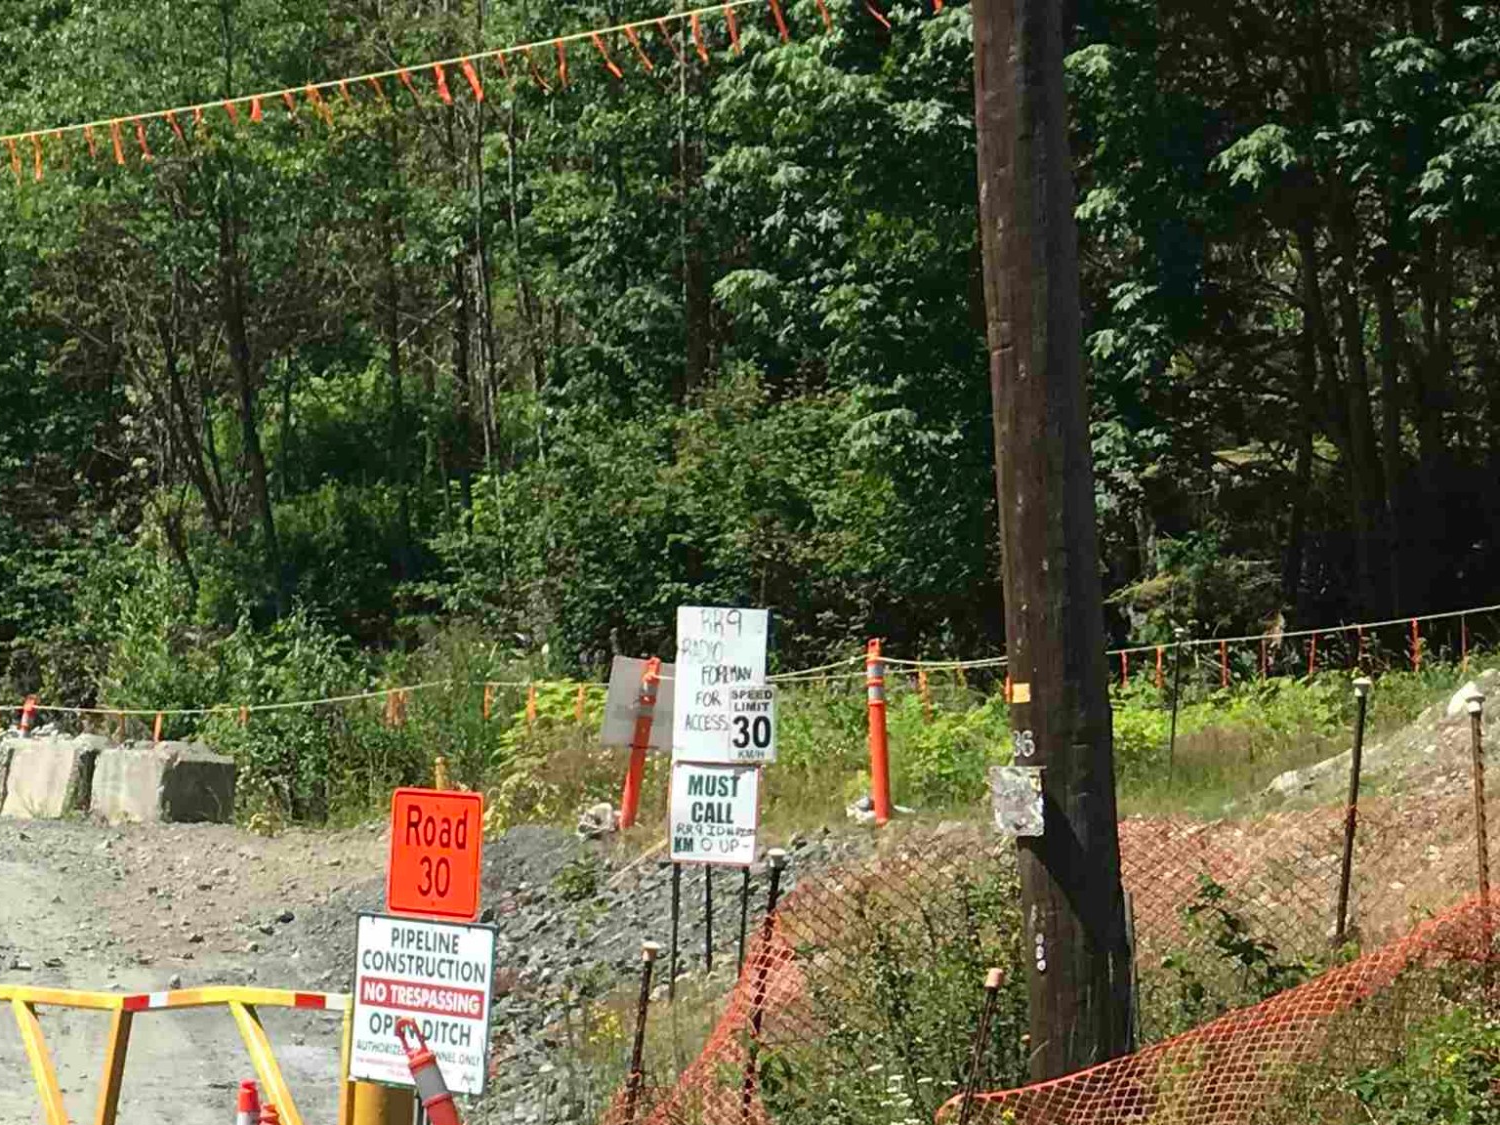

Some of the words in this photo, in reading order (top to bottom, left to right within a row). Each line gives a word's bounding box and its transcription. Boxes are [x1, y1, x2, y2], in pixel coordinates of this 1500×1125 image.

[701, 664, 752, 685] FOREMAN
[695, 691, 722, 707] FOR
[731, 689, 773, 700] SPEED
[734, 702, 770, 712] LIMIT
[685, 714, 729, 731] ACCESS
[732, 715, 771, 748] 30
[687, 775, 740, 797] MUST
[691, 801, 734, 824] CALL
[406, 804, 468, 850] Road
[673, 837, 694, 853] KM
[417, 855, 450, 898] 30
[391, 926, 460, 955] PIPELINE
[362, 949, 486, 983] CONSTRUCTION
[363, 980, 387, 1001] NO
[390, 984, 481, 1015] TRESPASSING
[422, 1019, 471, 1047] DITCH
[459, 1053, 480, 1067] ONLY
